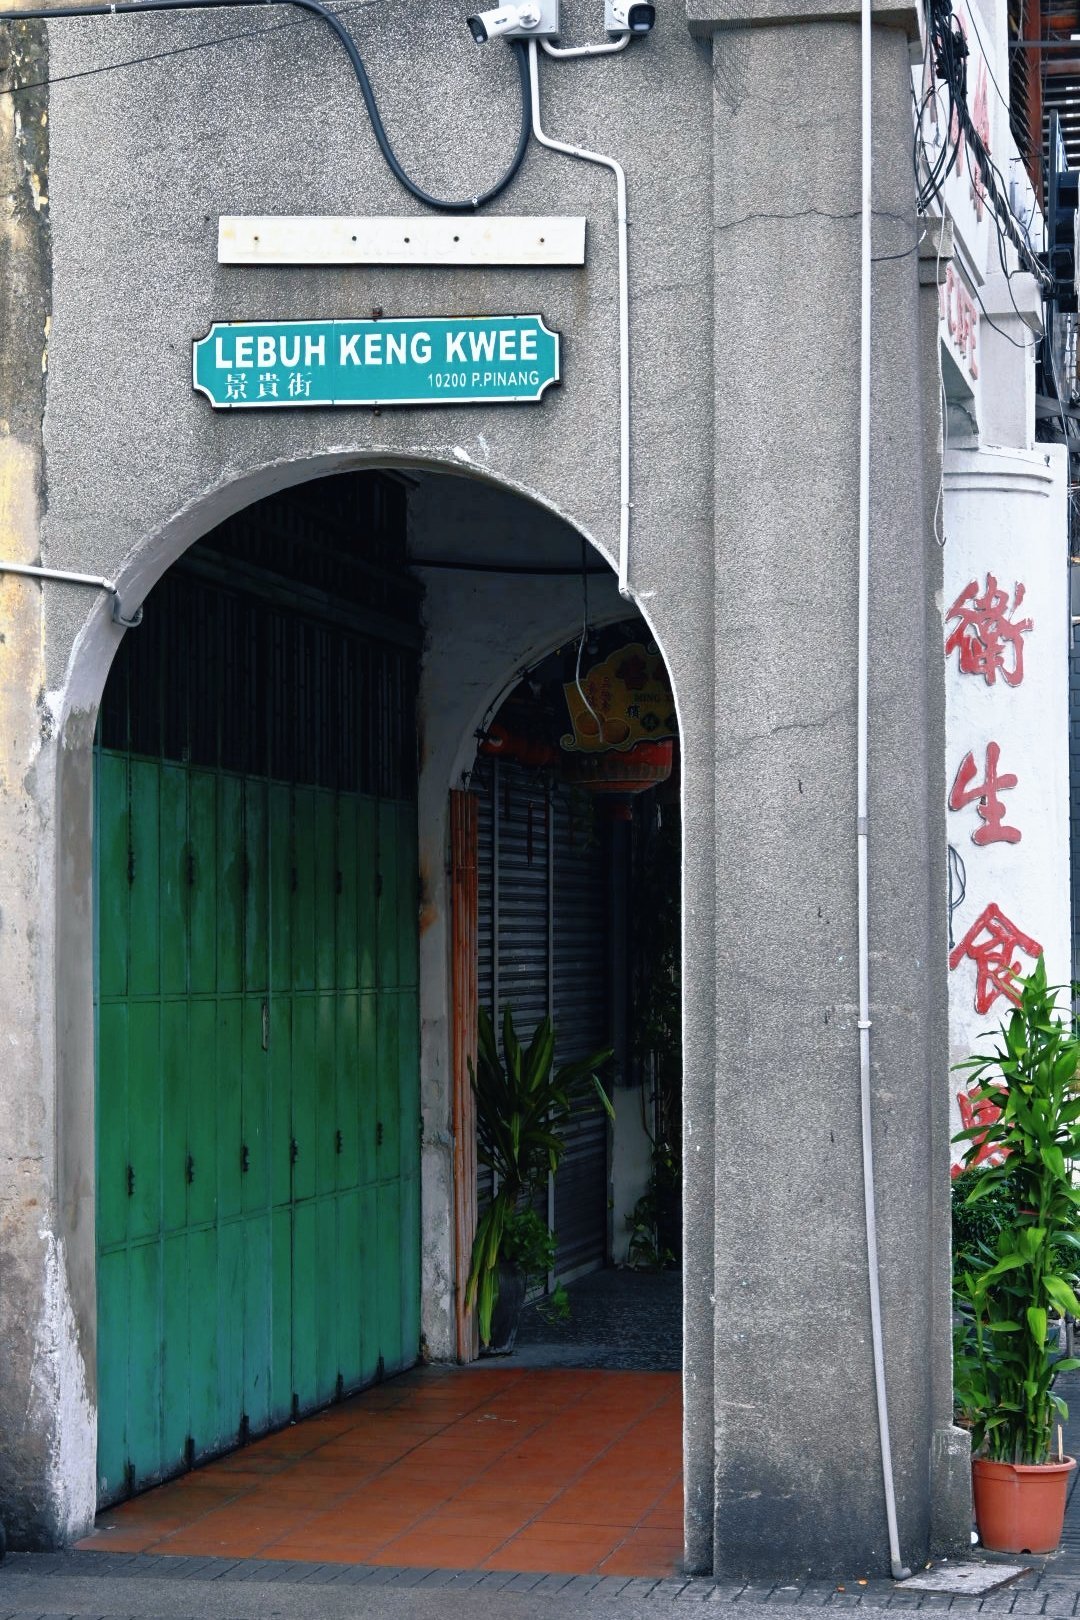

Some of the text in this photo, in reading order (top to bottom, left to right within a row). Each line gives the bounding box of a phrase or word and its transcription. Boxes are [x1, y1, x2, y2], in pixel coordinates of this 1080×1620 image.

[215, 329, 538, 369] LEBUH KENG KWEE
[224, 372, 312, 400] 景貴街
[428, 370, 540, 388] 10200 P.PINANG
